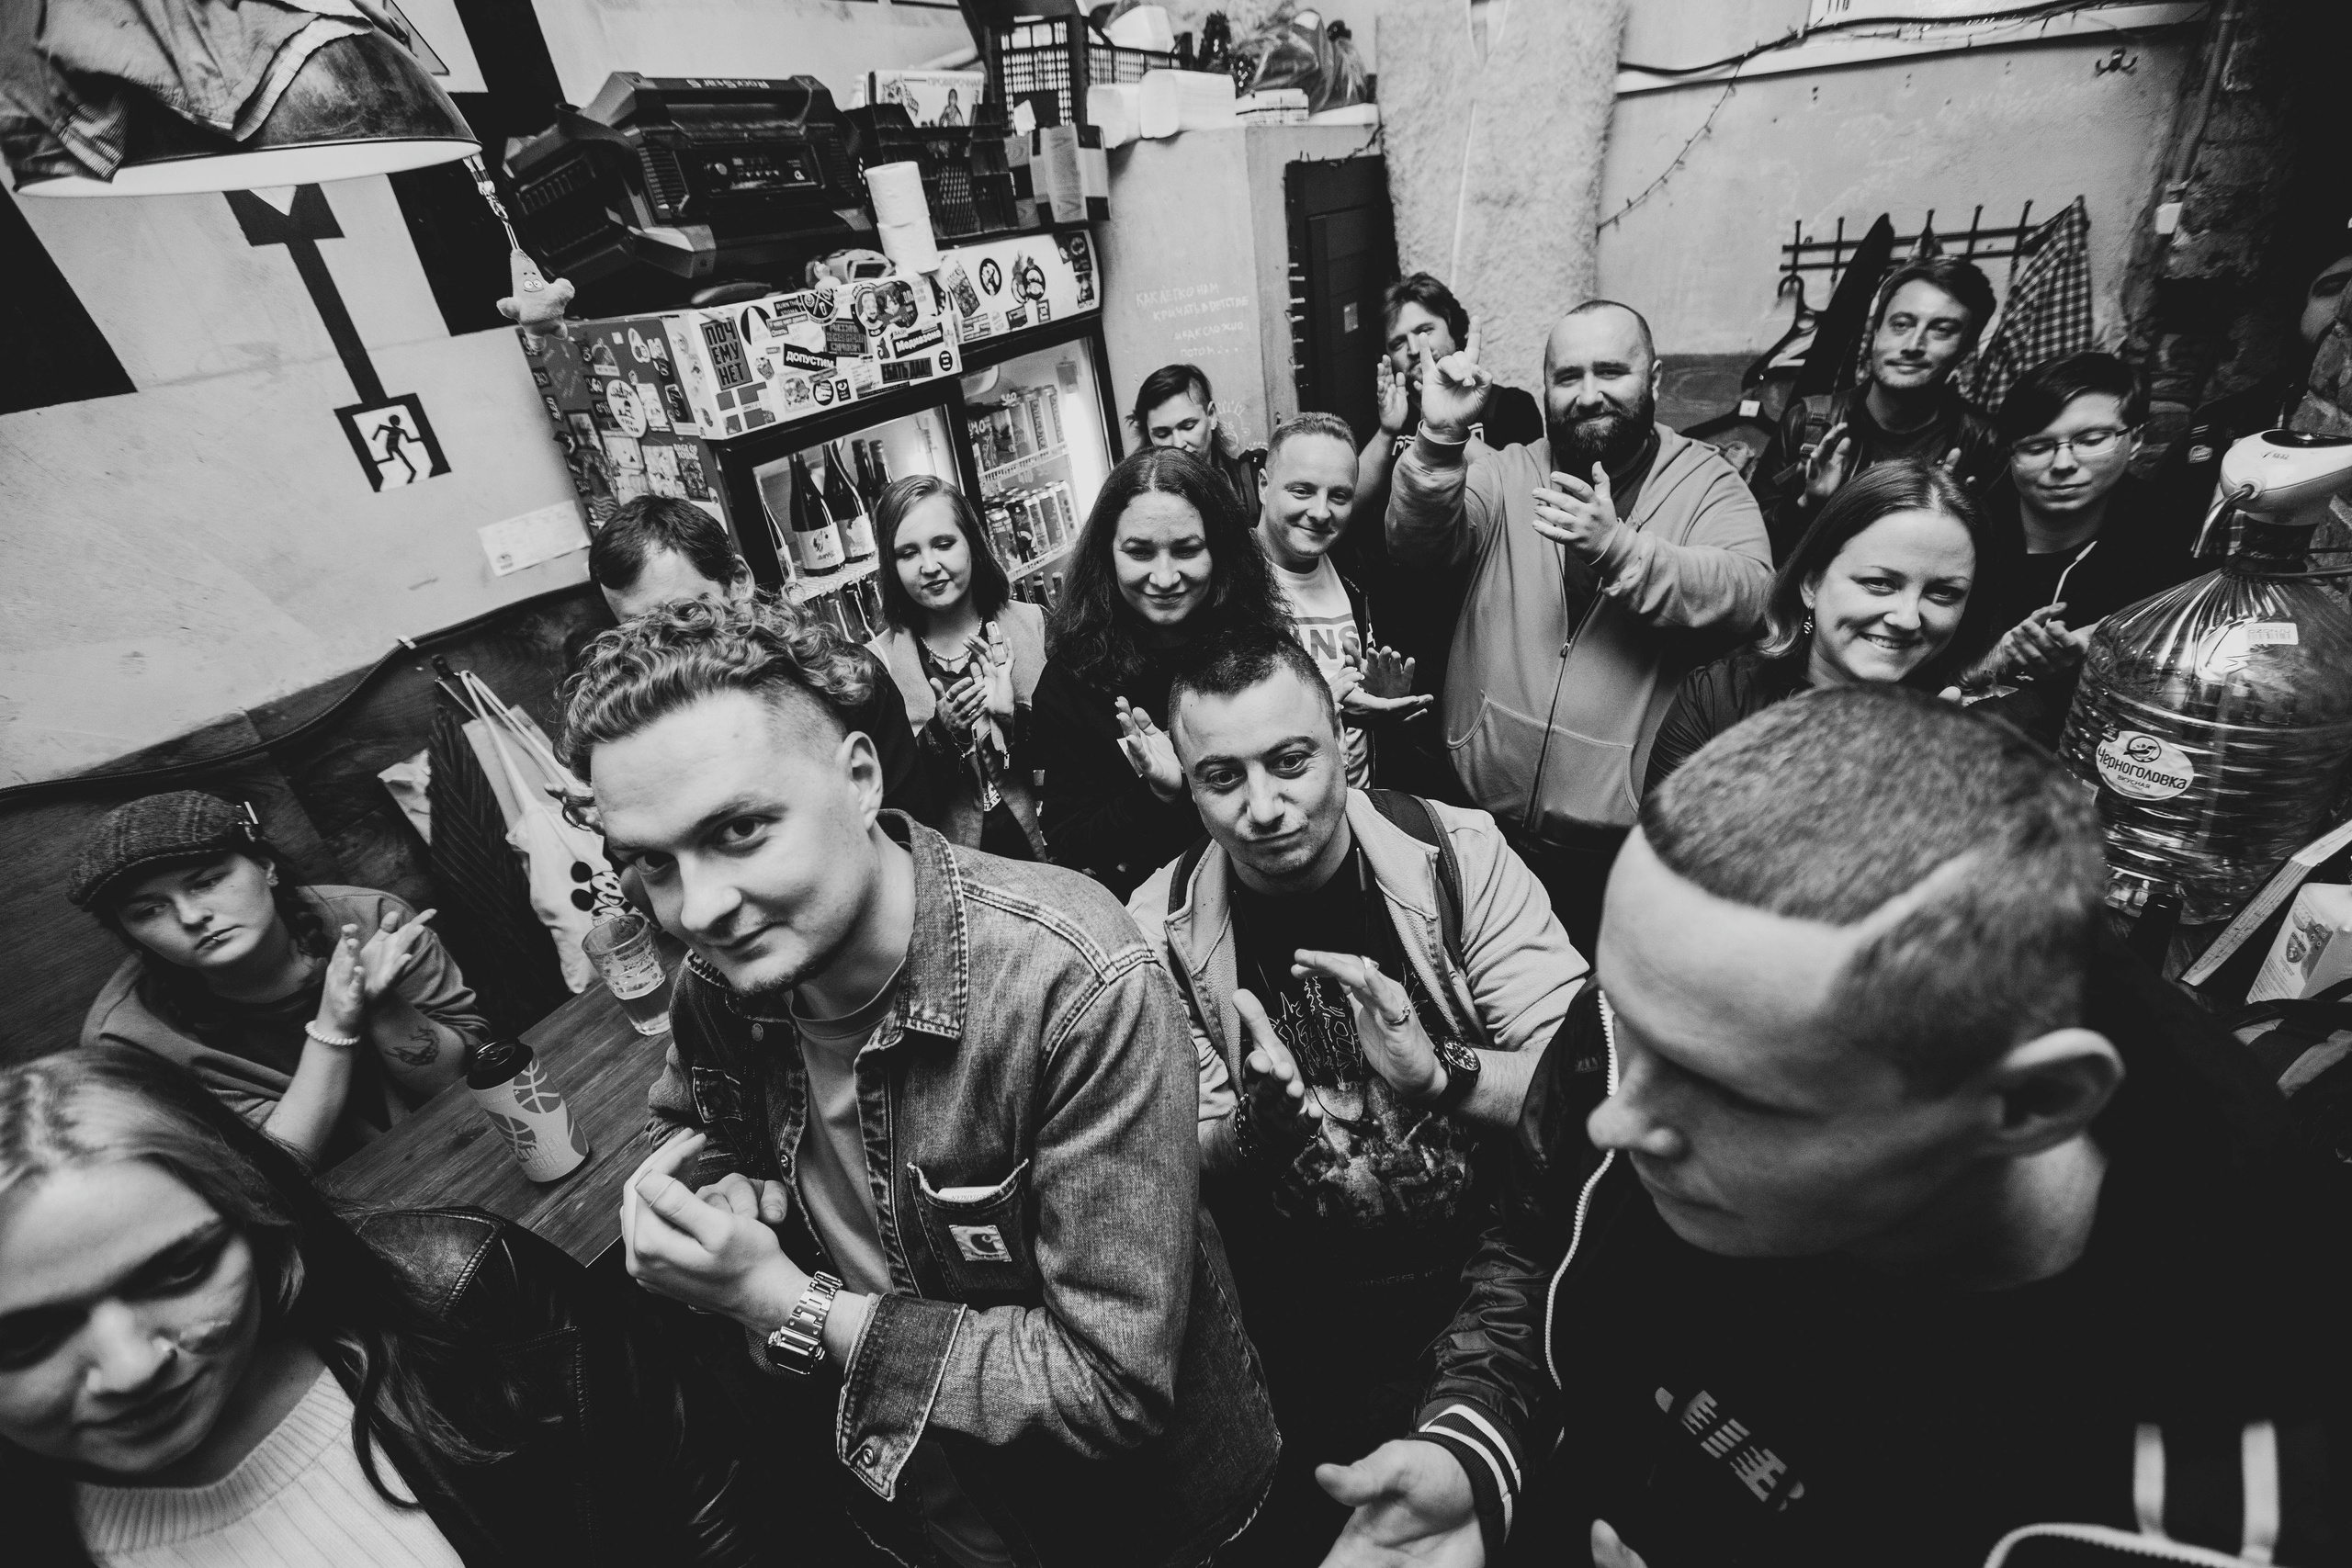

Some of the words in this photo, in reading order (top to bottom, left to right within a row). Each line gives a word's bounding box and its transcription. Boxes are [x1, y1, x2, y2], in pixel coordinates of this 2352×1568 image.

[706, 321, 736, 346] ПОЧ
[895, 329, 942, 352] Медиазона
[711, 341, 740, 365] ЕМУ
[786, 350, 835, 368] ДОПУСТИМ
[718, 362, 744, 386] НЕТ
[2098, 746, 2188, 790] Черноголовка
[2116, 773, 2152, 790] ВКУСНАЯ
